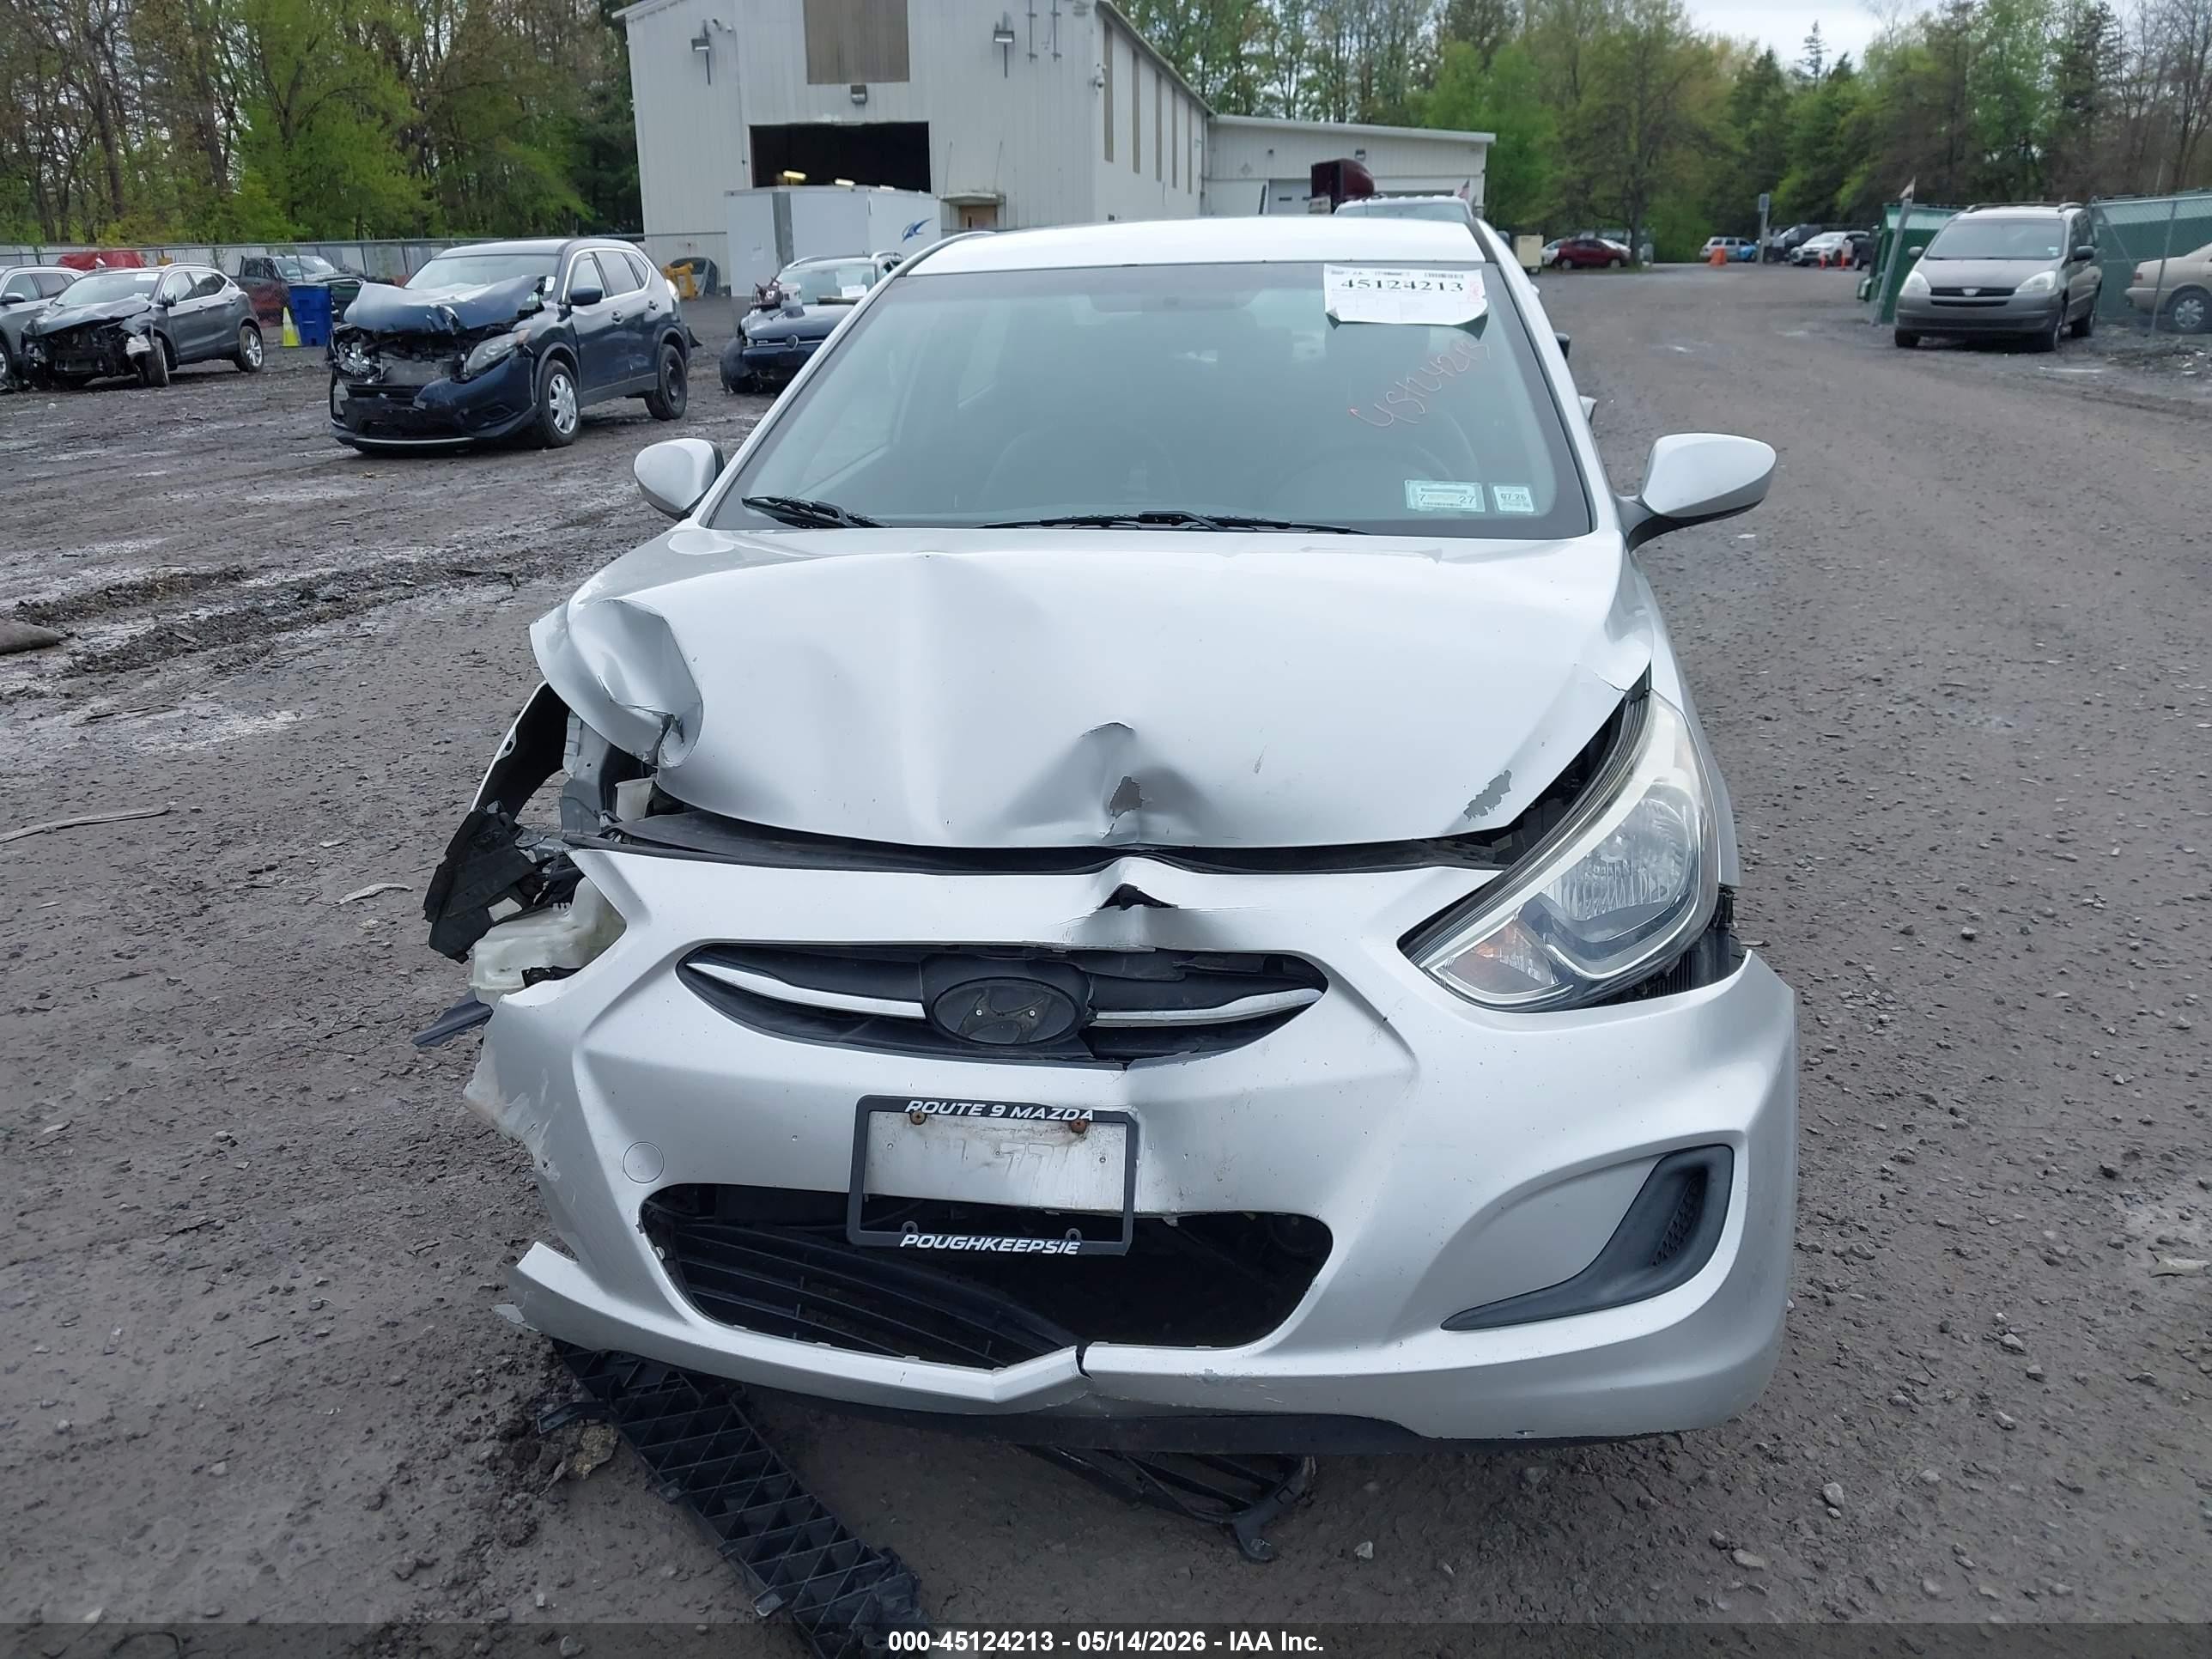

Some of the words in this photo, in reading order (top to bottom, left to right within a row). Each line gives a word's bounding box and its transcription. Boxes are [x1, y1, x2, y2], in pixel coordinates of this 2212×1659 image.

[1340, 279, 1464, 292] 45124213
[904, 1100, 986, 1117] ROUTE
[988, 1103, 1006, 1118] 9
[1009, 1105, 1095, 1121] MAZDA
[899, 1233, 1082, 1255] POUGHKEEPSIE
